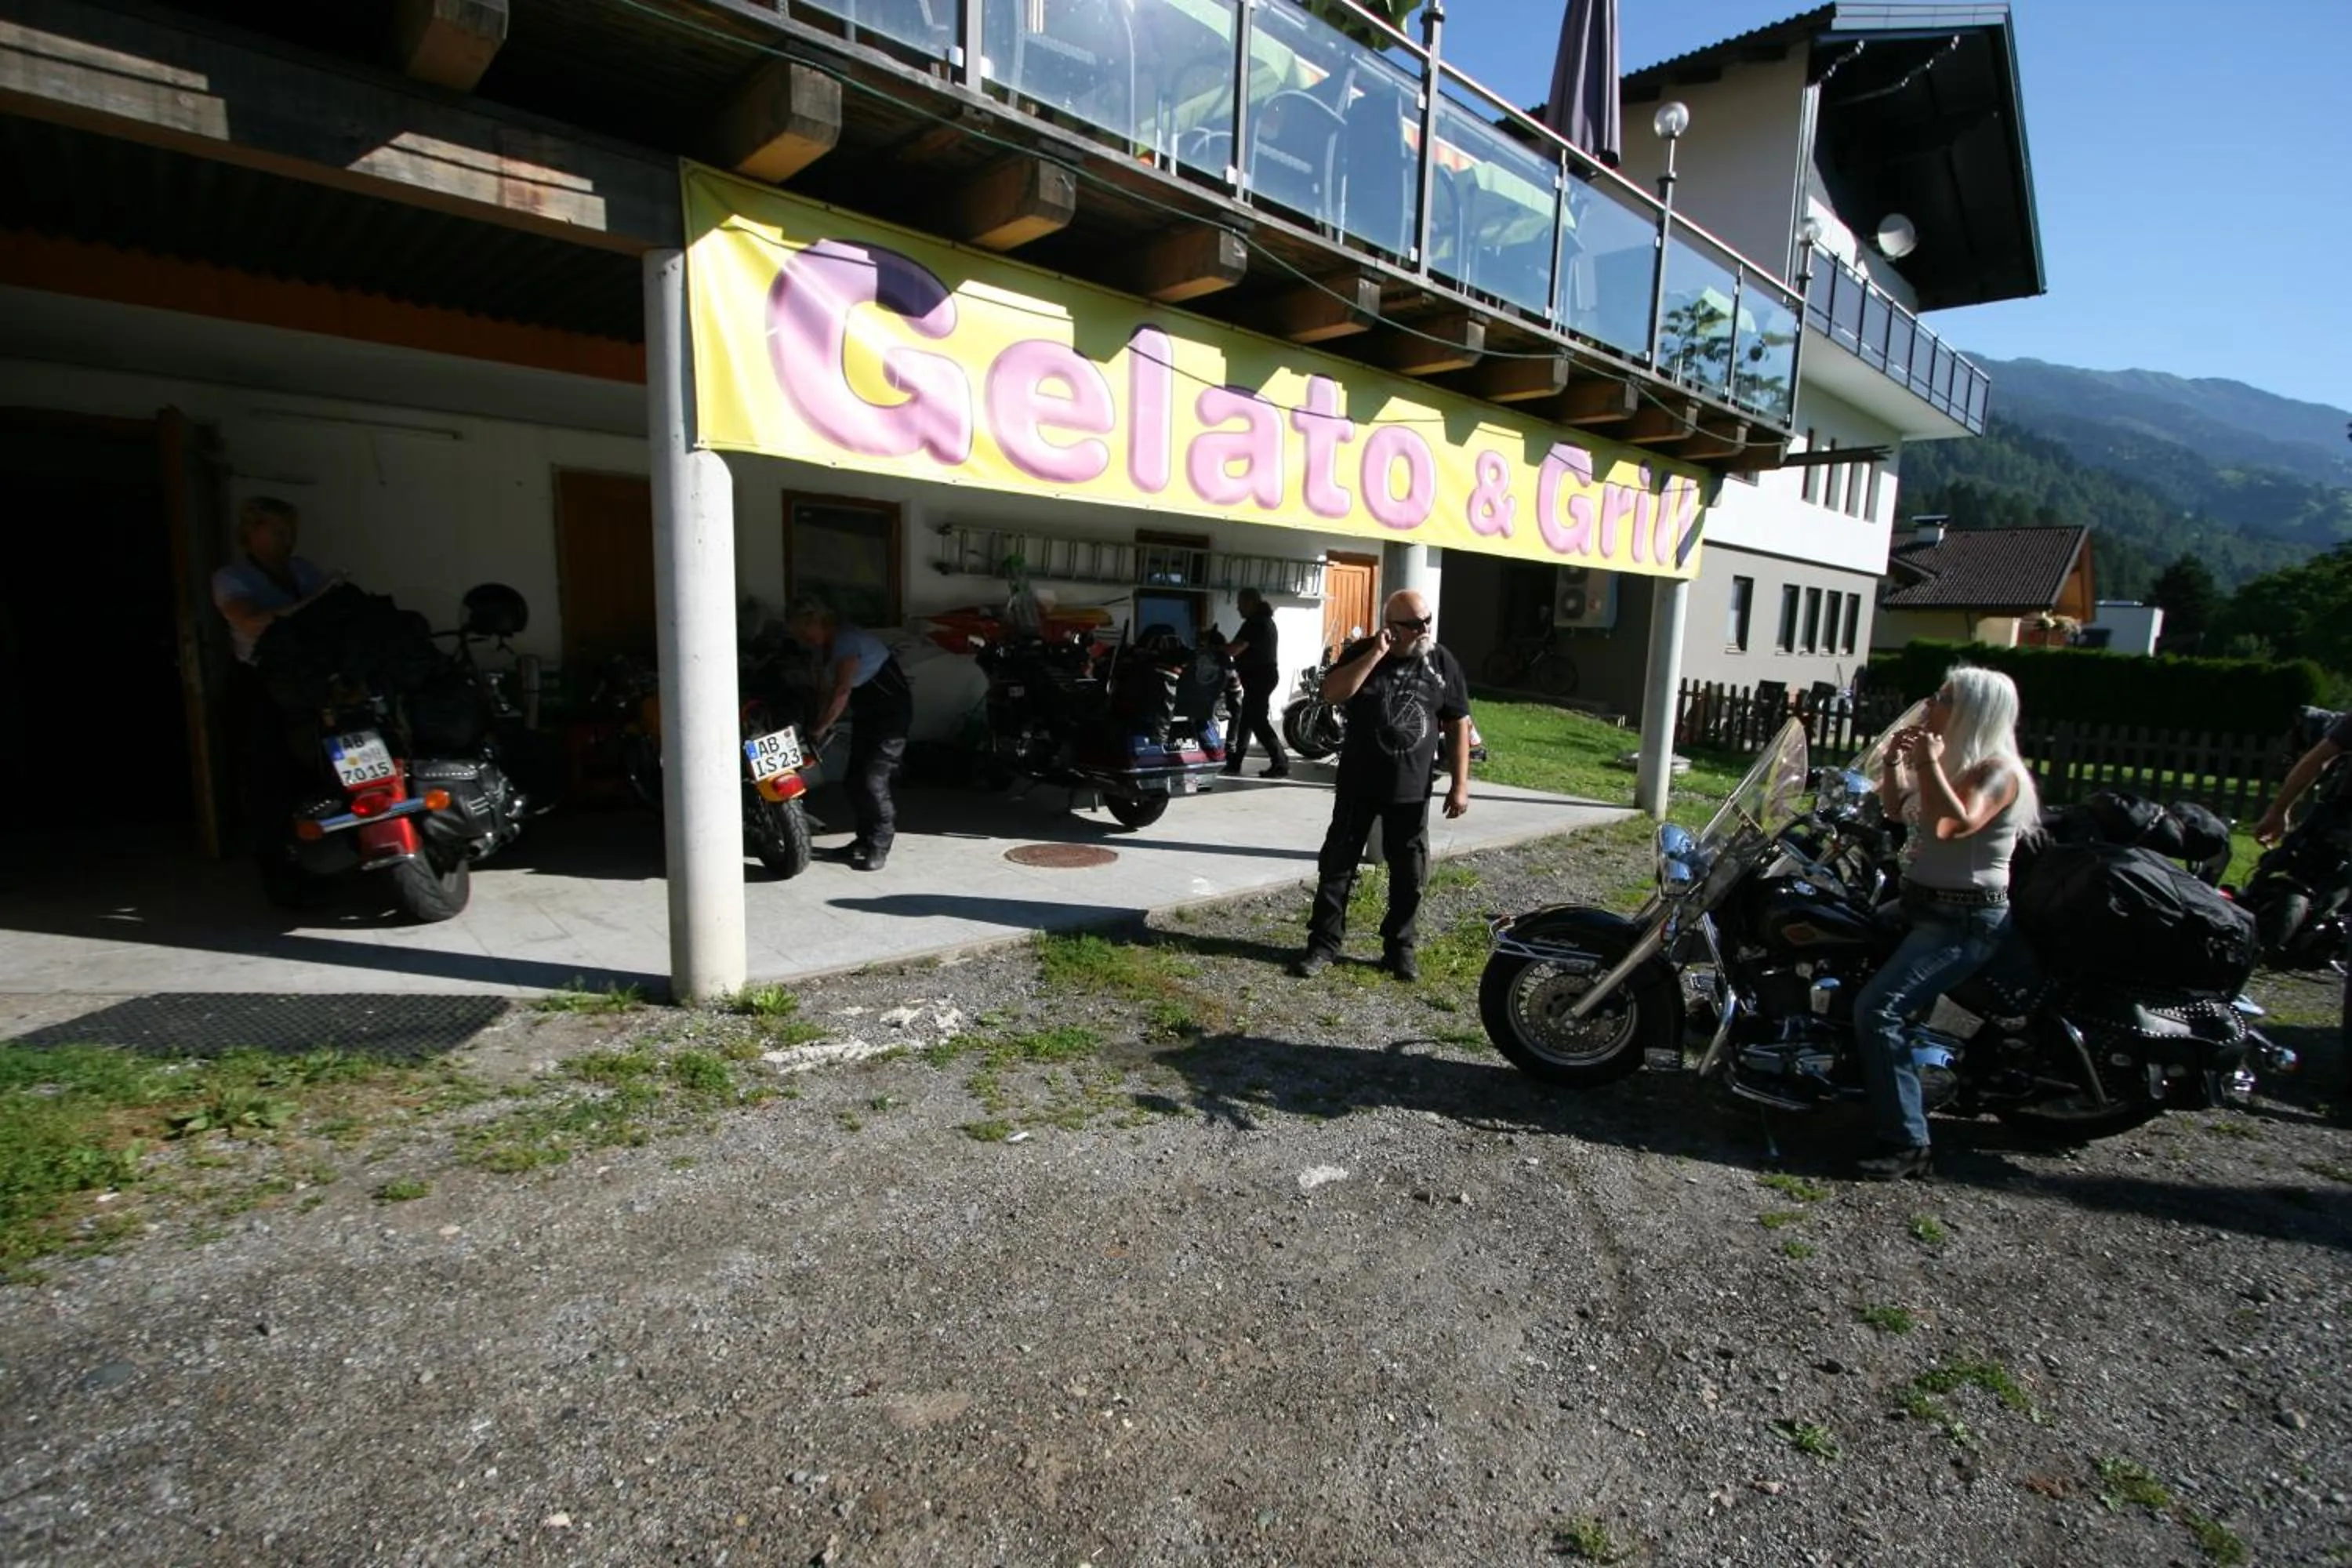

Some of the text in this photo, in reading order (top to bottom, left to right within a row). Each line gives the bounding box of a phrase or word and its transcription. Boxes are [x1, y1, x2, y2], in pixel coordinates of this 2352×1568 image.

[765, 238, 1698, 569] Gelato & Grill
[758, 736, 780, 756] AB
[779, 748, 800, 768] 23
